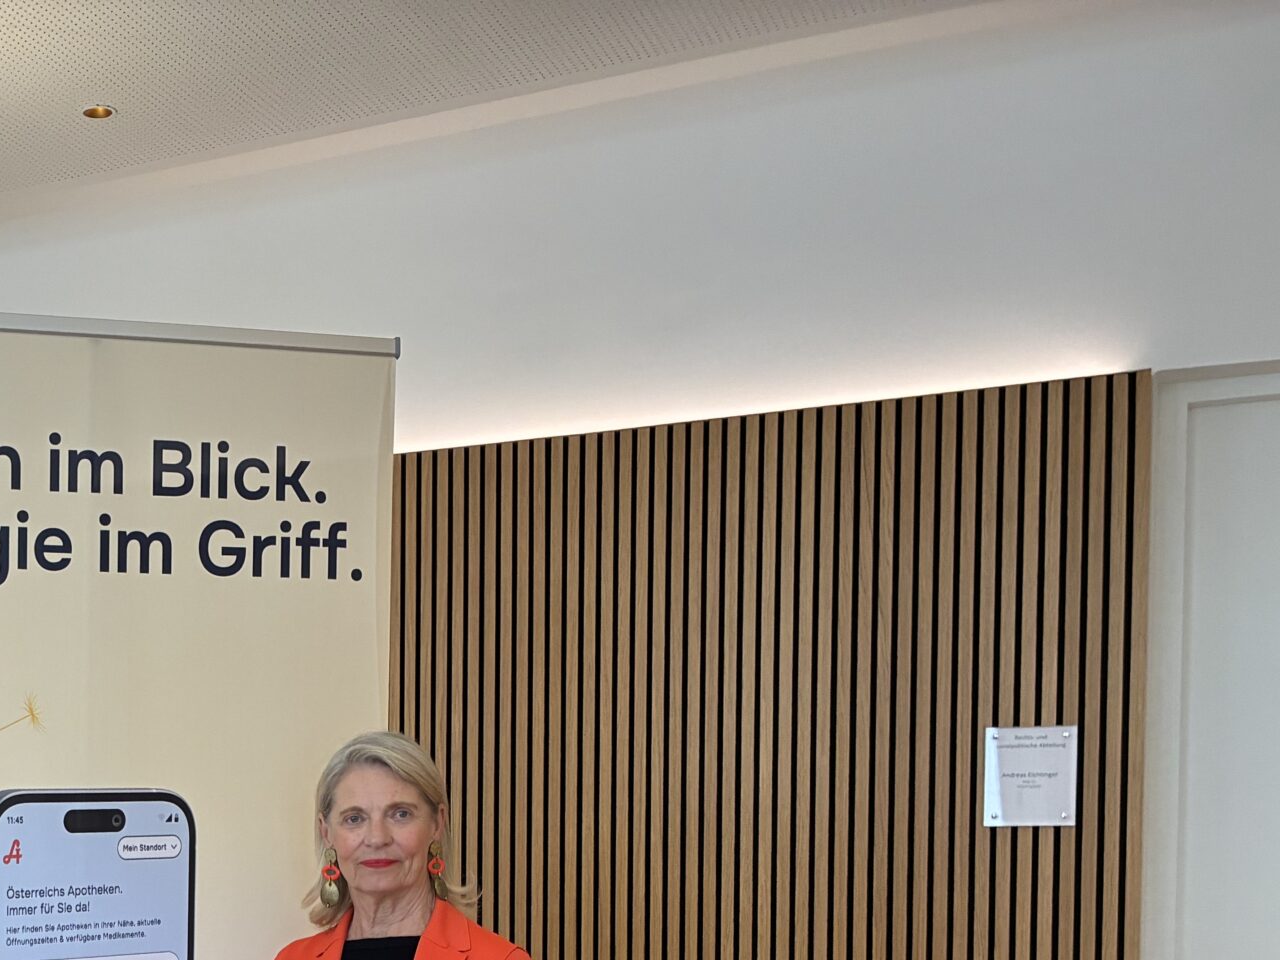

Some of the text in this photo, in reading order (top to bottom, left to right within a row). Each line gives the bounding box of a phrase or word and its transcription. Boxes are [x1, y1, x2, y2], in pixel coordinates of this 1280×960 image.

[48, 432, 124, 495] im
[152, 439, 328, 504] Blick.
[98, 513, 173, 575] im
[197, 520, 363, 582] Griff.
[7, 816, 23, 824] 11:45
[123, 843, 167, 852] Mein Standort
[6, 885, 123, 899] Österreichs Apotheken.
[6, 901, 90, 917] Immer für Sie da!
[6, 918, 161, 934] Hier finden Sie Apotheken in Ihrer Nähe, aktuelle
[6, 936, 58, 946] Öffnungszeiten
[66, 932, 101, 943] verfügbare
[103, 931, 146, 940] Medikamente.
